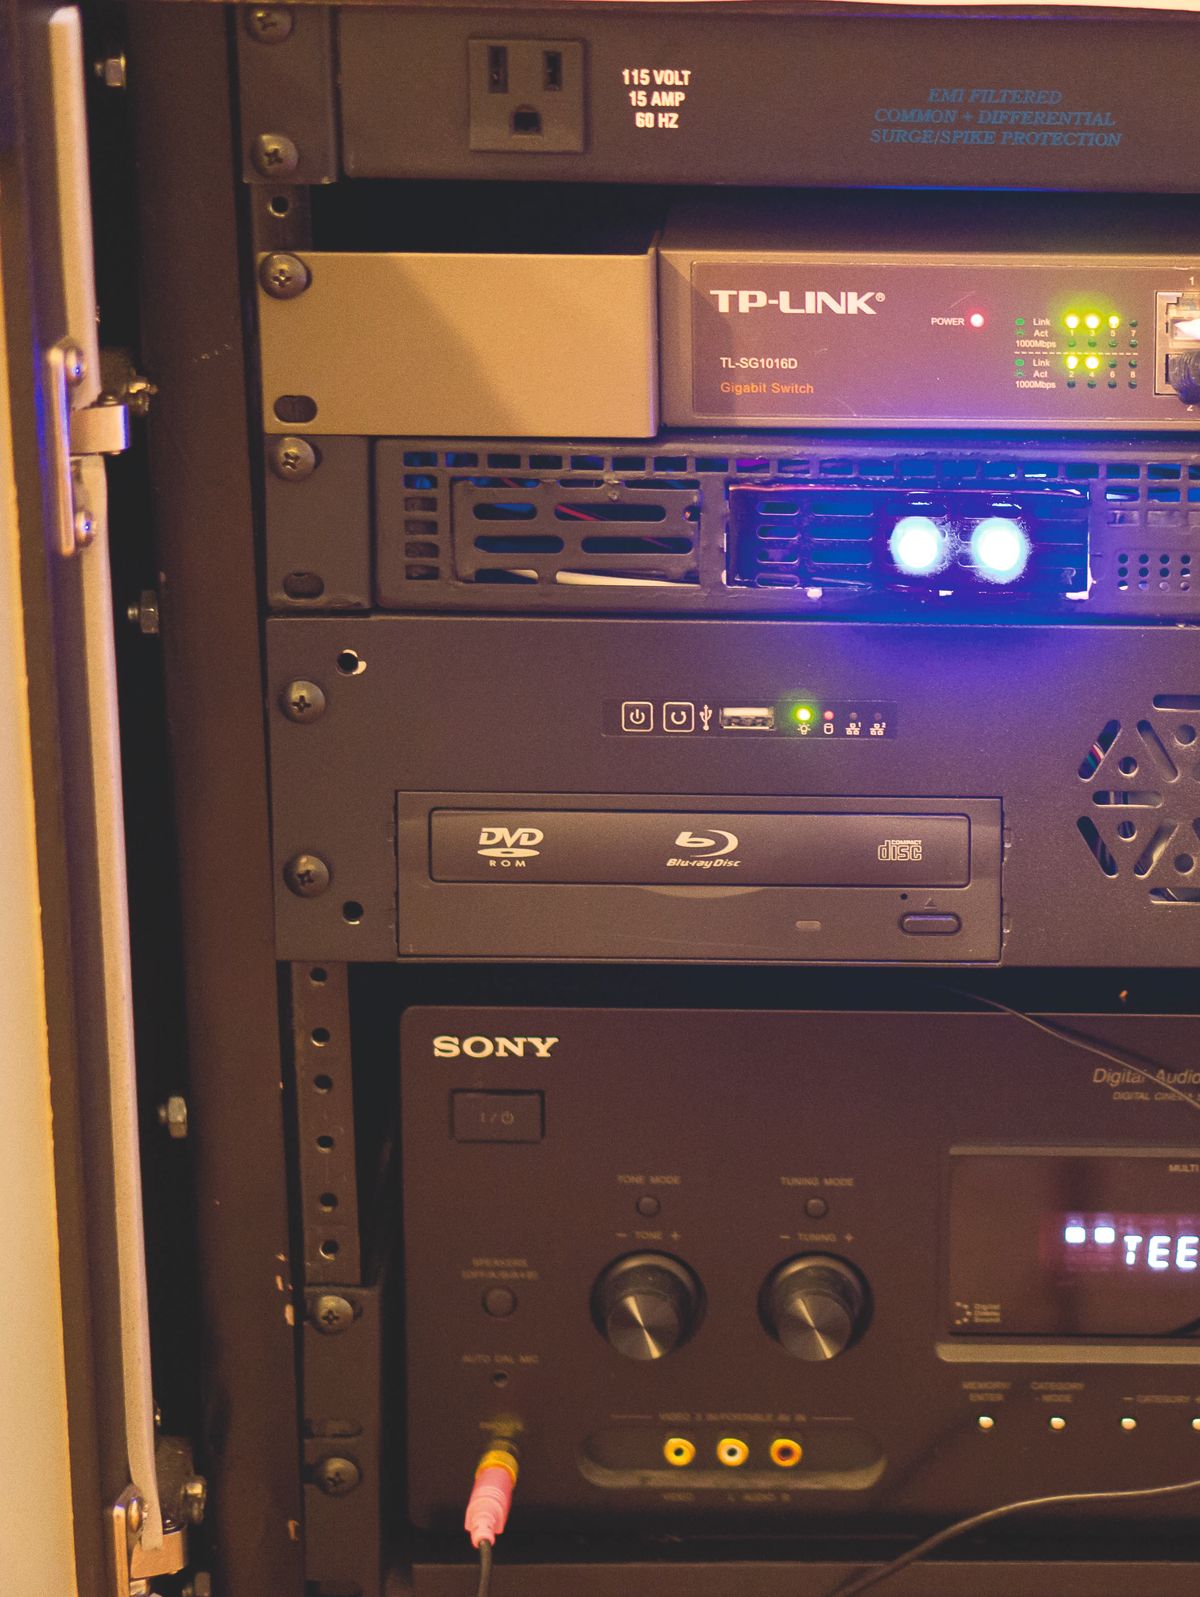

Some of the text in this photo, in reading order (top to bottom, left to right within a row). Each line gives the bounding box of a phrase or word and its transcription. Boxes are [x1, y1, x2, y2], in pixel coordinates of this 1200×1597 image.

[622, 68, 692, 85] 115 VOLT
[629, 91, 686, 107] 15 AMP
[928, 88, 1063, 105] EMI FILTERED
[635, 112, 679, 128] 60 HZ
[874, 109, 958, 124] COMMON
[977, 111, 1117, 127] DIFFERENTIAL
[869, 129, 1122, 147] SURGE/SPIKE PROTECTION
[1189, 277, 1194, 286] 1
[931, 317, 965, 327] POWER
[1033, 318, 1050, 327] Link
[1034, 329, 1049, 338] Act
[1015, 339, 1057, 350] 1000Mbps
[720, 357, 798, 369] TL-SG1016D
[1033, 359, 1050, 367] Link
[1034, 370, 1048, 378] Act
[720, 382, 814, 395] Gigabit Switch
[1015, 380, 1057, 390] 1000Mbps
[479, 827, 544, 848] DVD
[666, 858, 741, 869] Blu-ray Disc
[433, 1036, 559, 1057] SONY
[1169, 1164, 1199, 1172] MULTI
[780, 1176, 855, 1186] TUNING MODE
